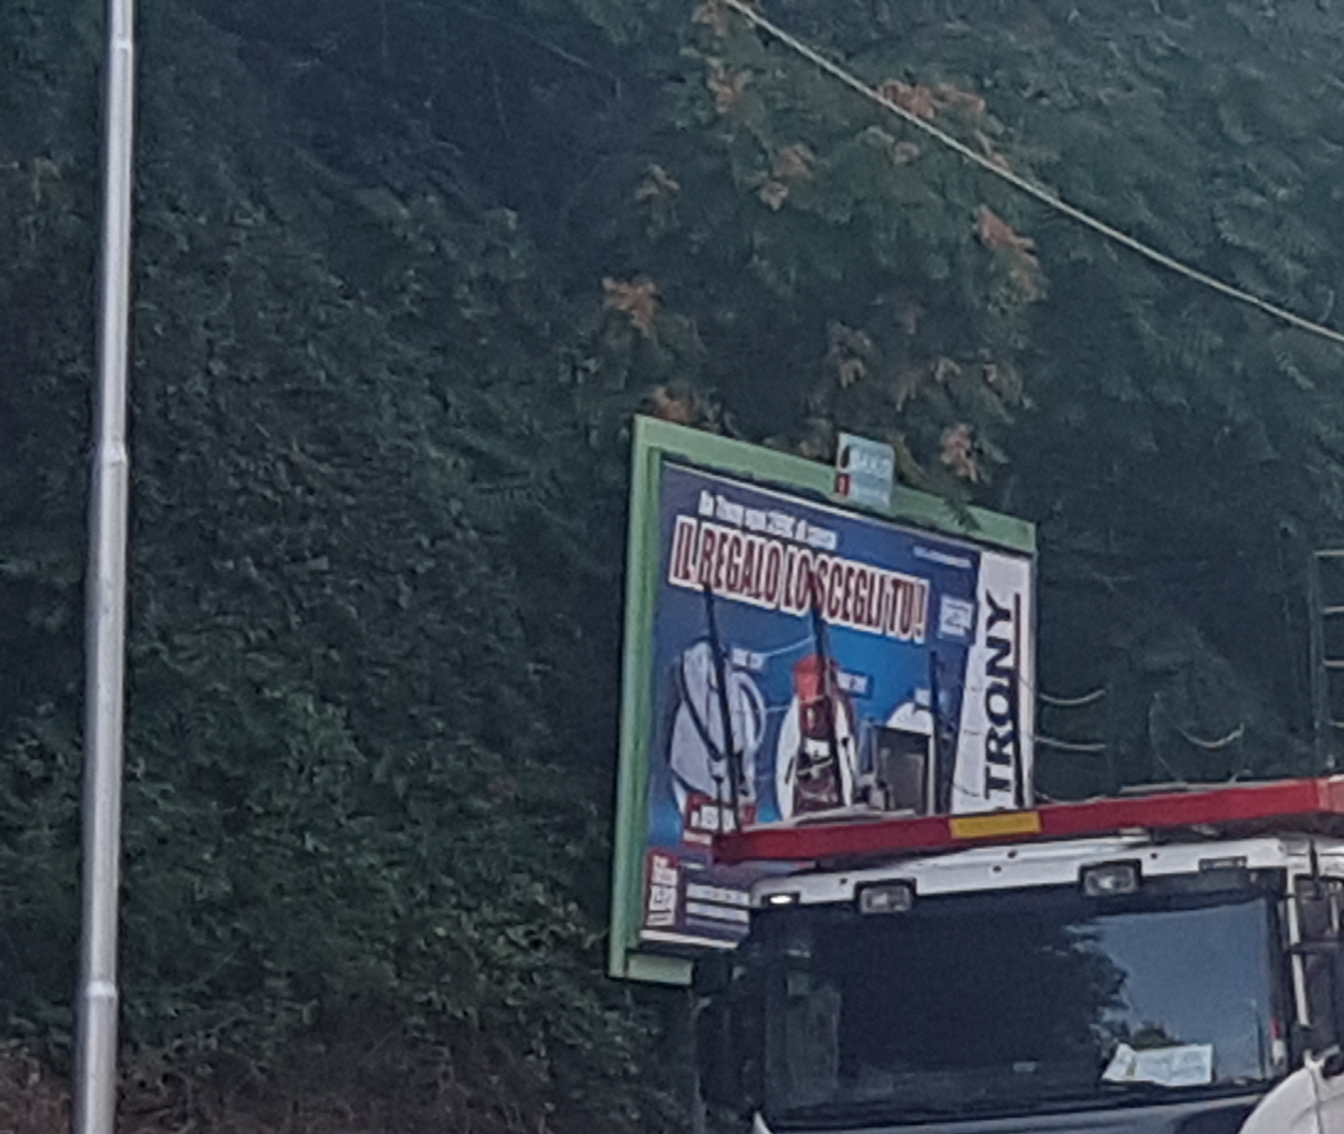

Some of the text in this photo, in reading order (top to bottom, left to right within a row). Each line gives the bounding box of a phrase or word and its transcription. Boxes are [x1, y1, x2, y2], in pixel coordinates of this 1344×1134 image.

[671, 518, 696, 583] IL
[699, 527, 783, 604] REGALO
[784, 549, 812, 612] LO
[816, 557, 885, 629] SCEGLI
[984, 588, 1014, 801] TRONY
